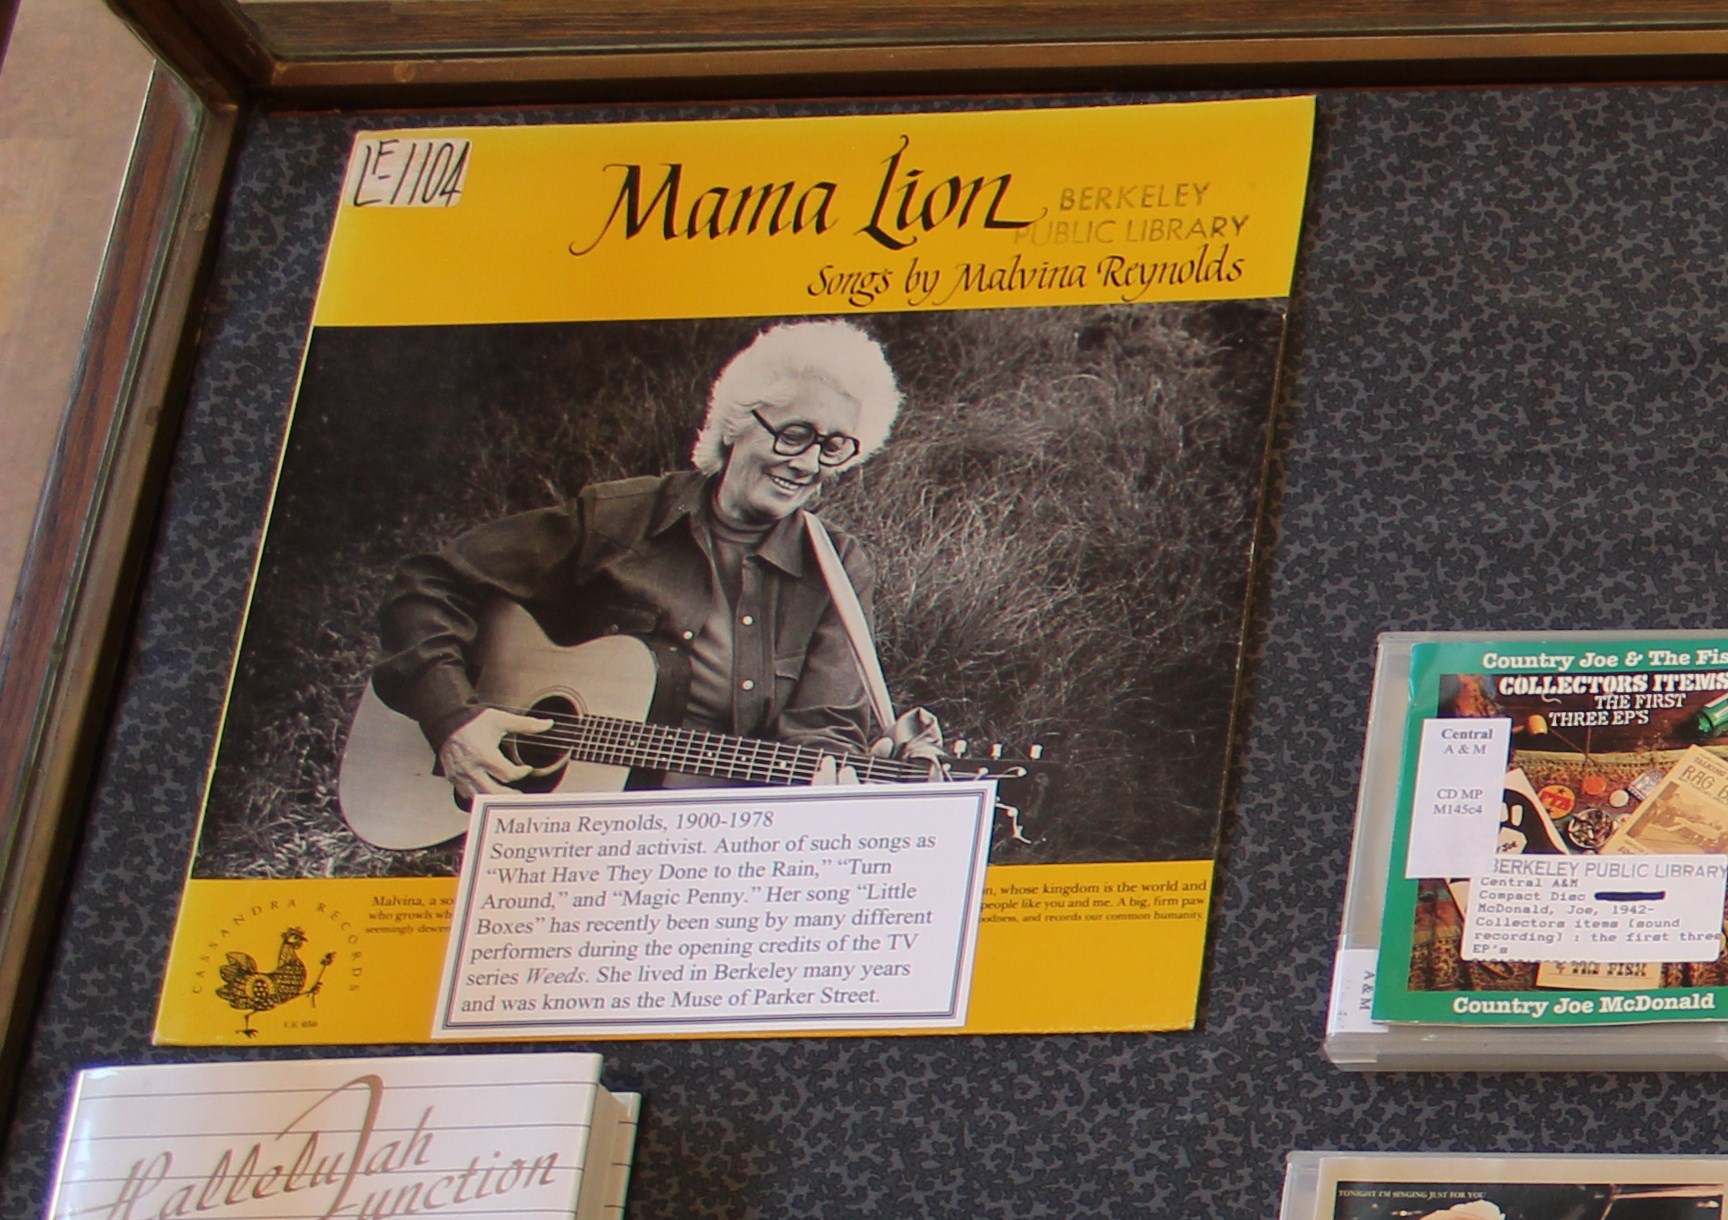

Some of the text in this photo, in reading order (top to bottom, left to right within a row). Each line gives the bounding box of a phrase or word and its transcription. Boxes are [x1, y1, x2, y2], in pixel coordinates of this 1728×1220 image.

[569, 134, 1047, 257] Mama Lion
[1059, 182, 1211, 212] BERKELEY
[1015, 215, 1249, 246] PUBLIC LIBRARY
[808, 253, 1244, 307] Songs by Malvina Reynolds
[1483, 652, 1572, 671] Country
[1580, 652, 1619, 669] Joe
[1625, 652, 1643, 667] &
[1648, 651, 1684, 667] The
[1499, 674, 1648, 695] COLLECTORS
[1595, 694, 1686, 711] THE FIRST
[1549, 711, 1608, 726] THREE
[1437, 789, 1483, 799] CD MP
[493, 810, 775, 837] Malvina Reynolds, 1900-1978
[1000, 880, 1206, 896] whose kingdom is the world and
[1478, 904, 1655, 916] McDonald, Joe, 1942-
[1454, 993, 1715, 1016] Country Joe McDonald
